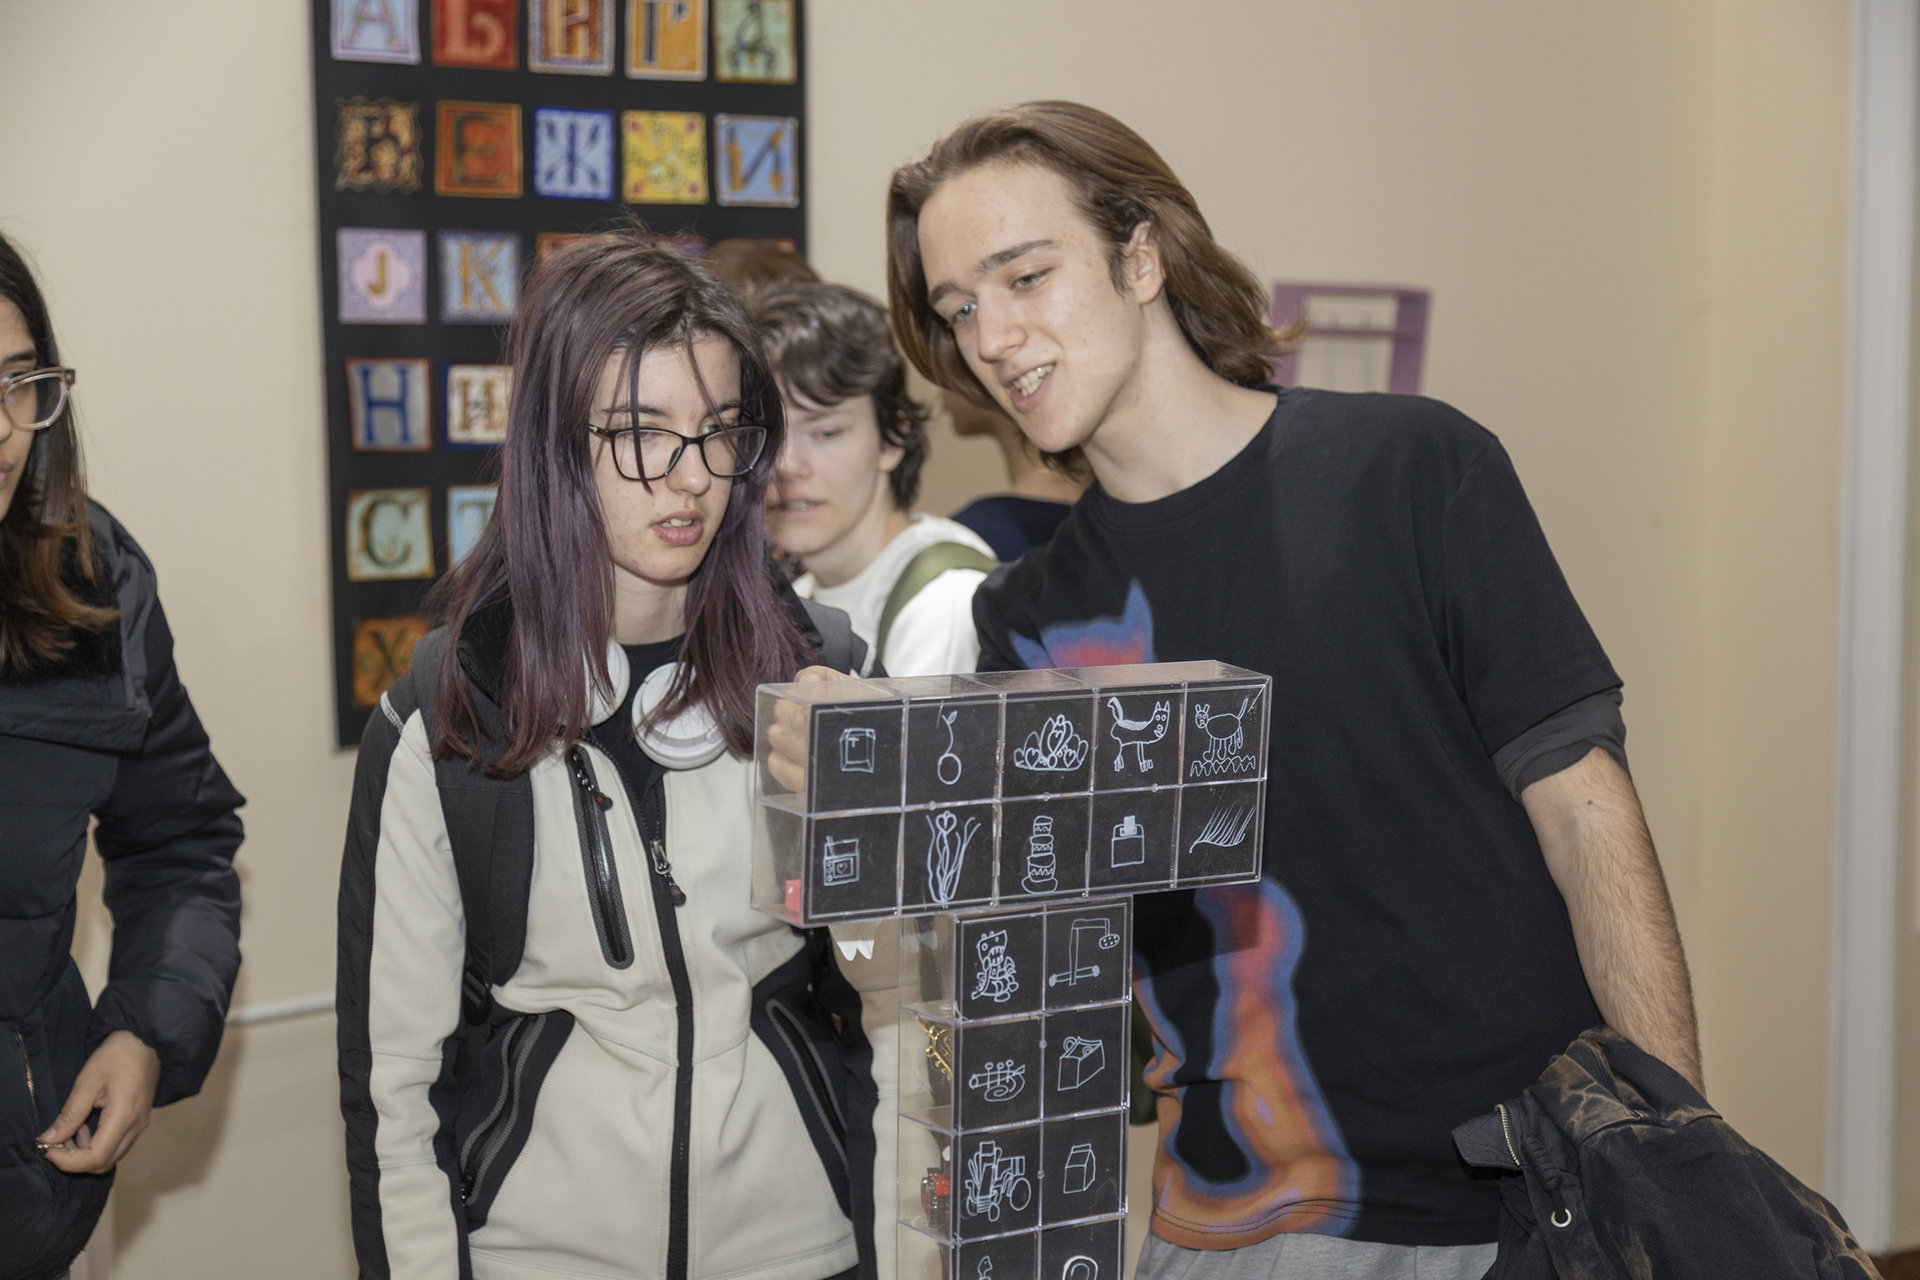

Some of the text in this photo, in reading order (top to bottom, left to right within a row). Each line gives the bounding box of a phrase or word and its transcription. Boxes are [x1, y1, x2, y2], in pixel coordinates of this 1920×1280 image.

[452, 112, 506, 185] Е
[544, 118, 600, 186] Ж
[649, 122, 682, 192] З
[727, 126, 784, 192] И
[459, 242, 503, 310] К
[356, 365, 417, 444] Н
[361, 499, 413, 569] С
